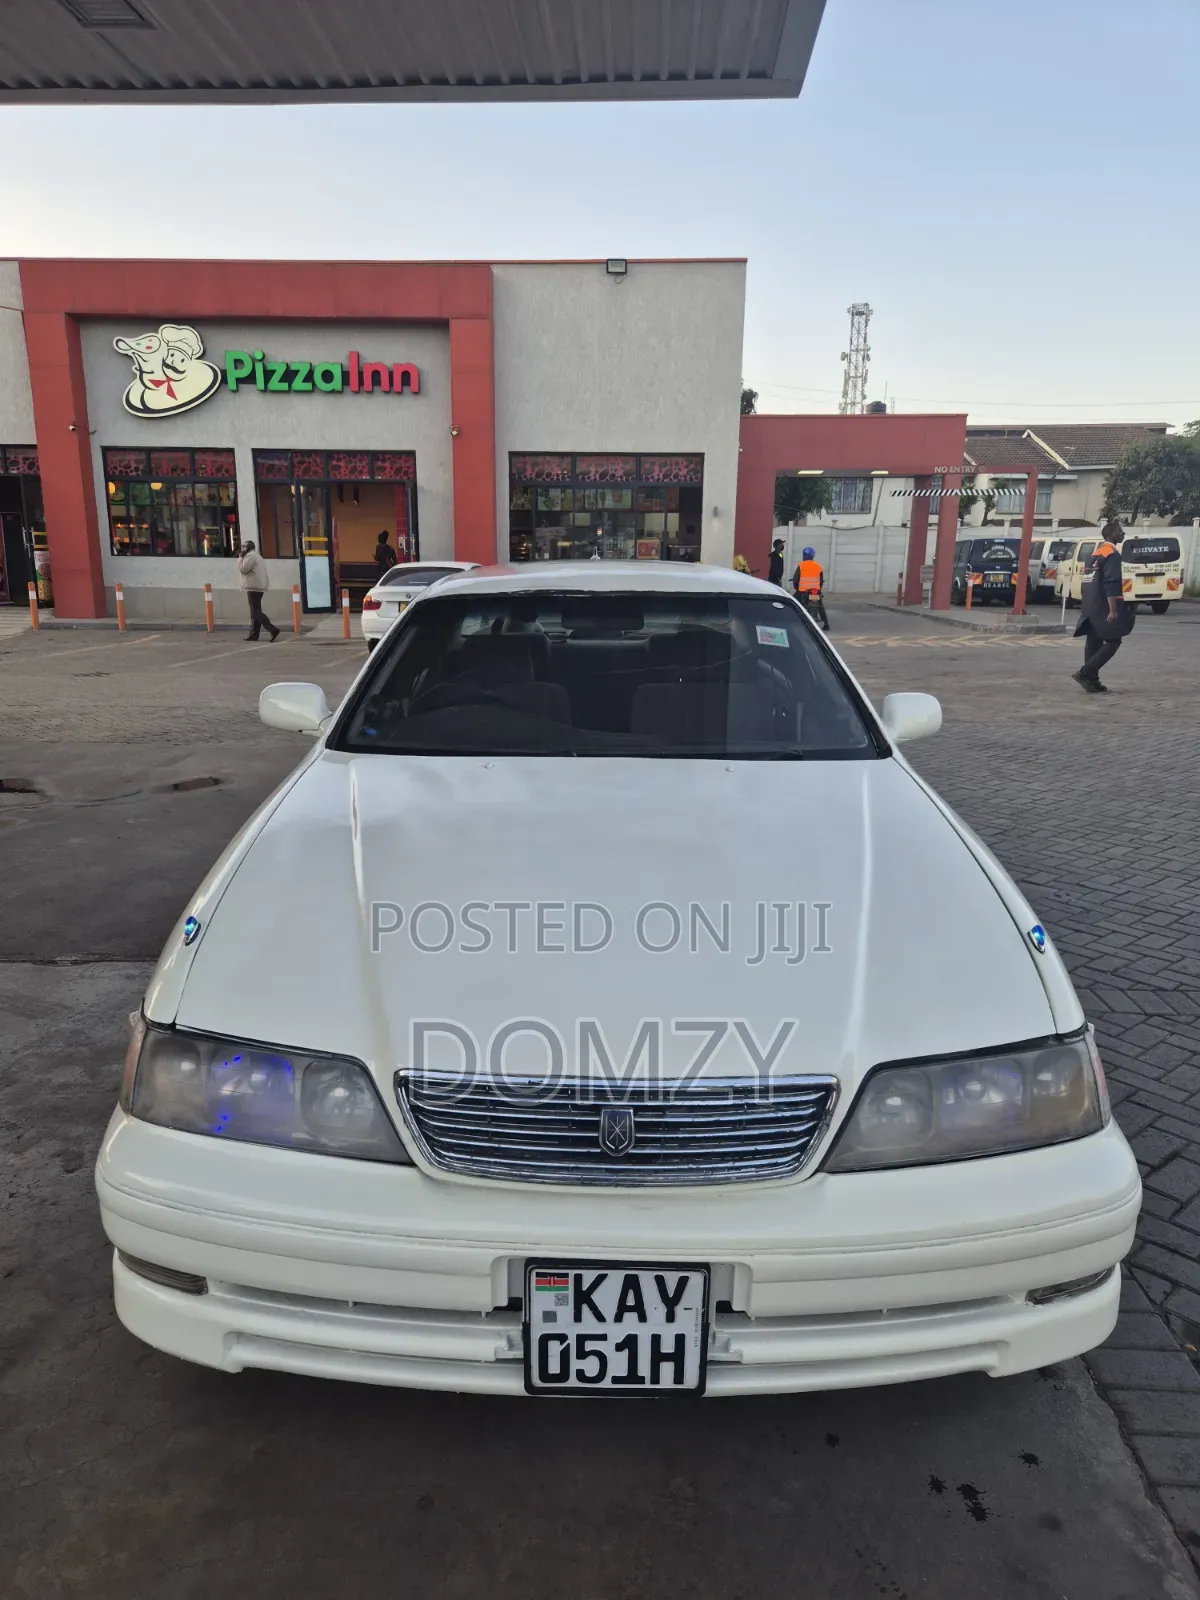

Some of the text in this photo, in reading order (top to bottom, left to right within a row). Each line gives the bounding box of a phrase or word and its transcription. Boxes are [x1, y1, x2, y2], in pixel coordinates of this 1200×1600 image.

[224, 350, 420, 393] Pizza Inn
[934, 465, 976, 474] NO ENTRY
[573, 1273, 690, 1323] KAY
[538, 1332, 686, 1385] 051H
